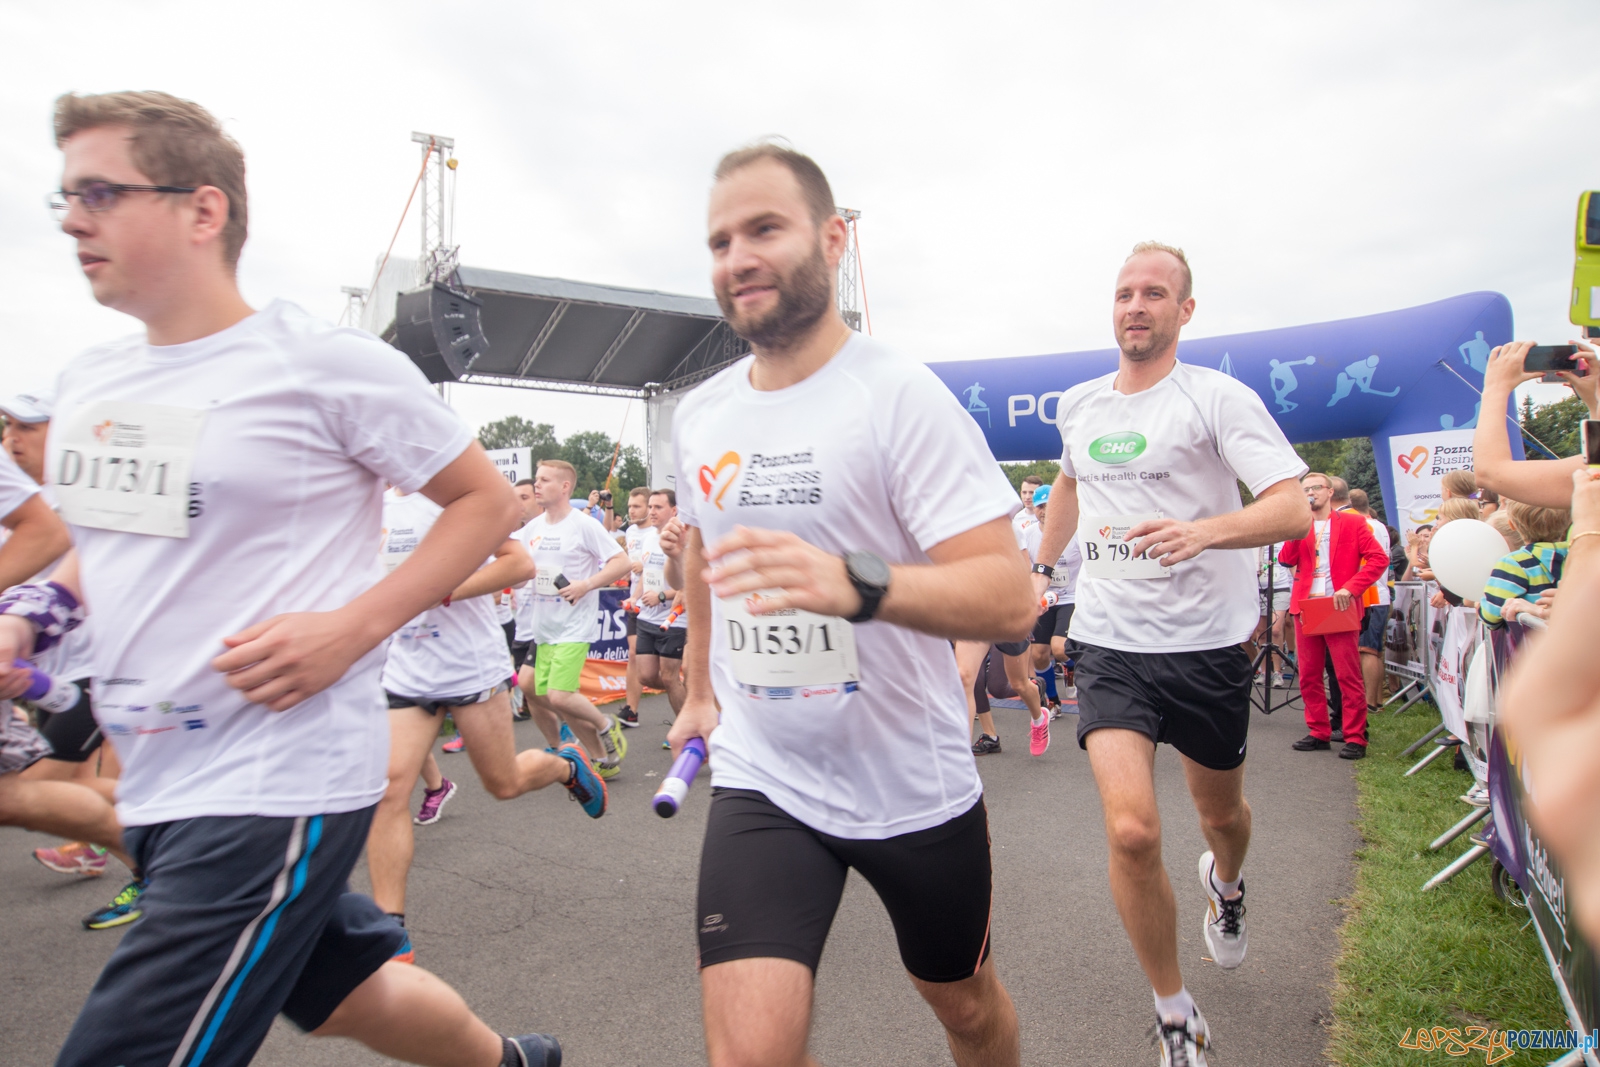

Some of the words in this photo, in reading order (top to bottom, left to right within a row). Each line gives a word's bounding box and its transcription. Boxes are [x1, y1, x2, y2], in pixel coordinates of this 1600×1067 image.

[512, 453, 518, 465] A
[1102, 472, 1137, 481] Health
[1140, 471, 1170, 481] Caps
[738, 490, 772, 506] Run
[775, 487, 822, 505] 2016
[1085, 541, 1099, 560] B
[604, 647, 629, 660] deliv
